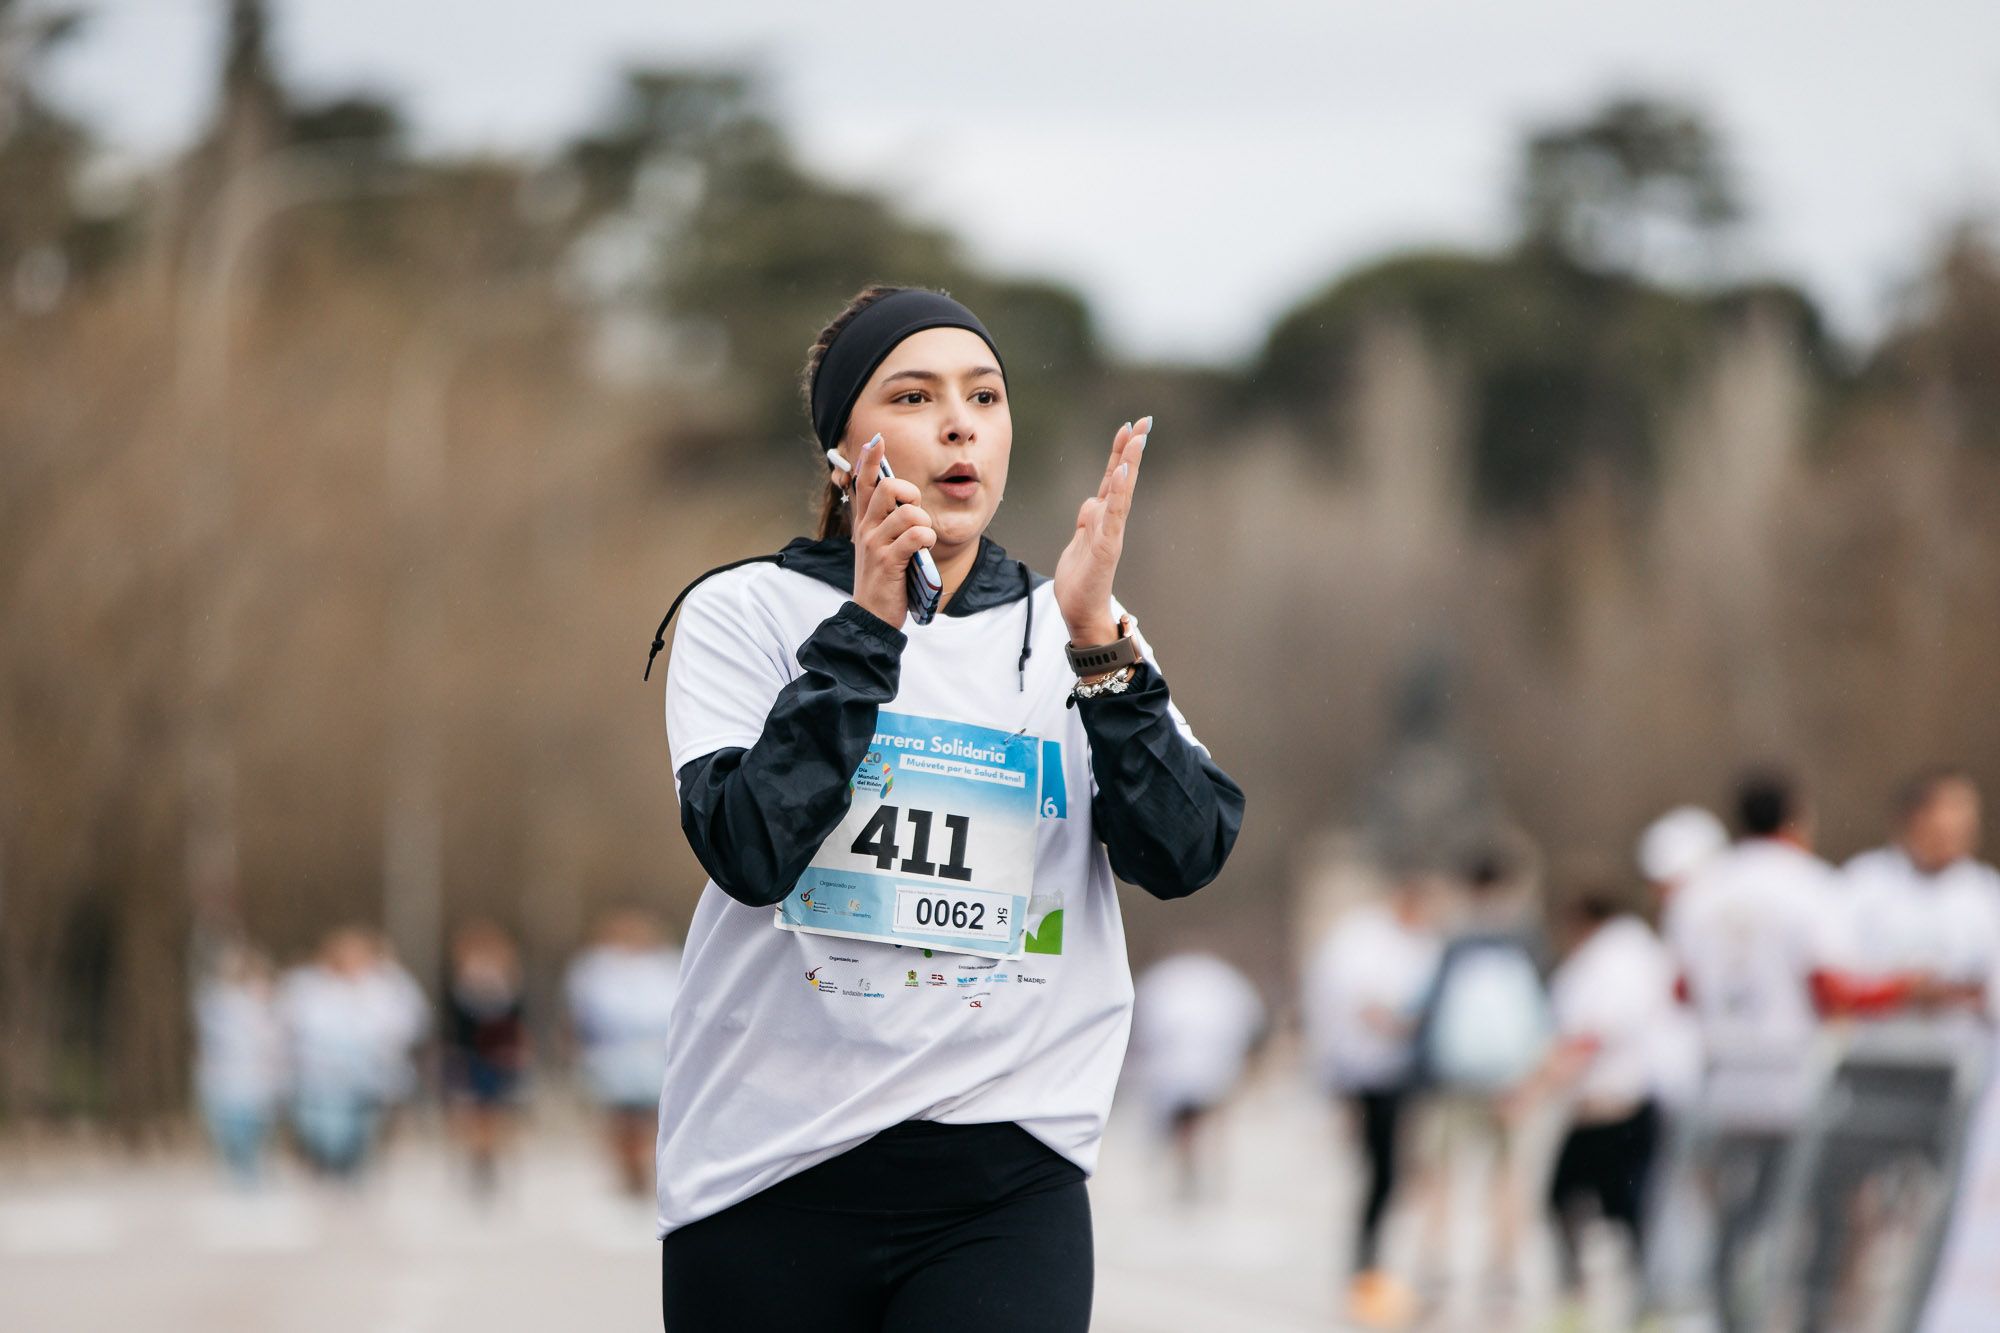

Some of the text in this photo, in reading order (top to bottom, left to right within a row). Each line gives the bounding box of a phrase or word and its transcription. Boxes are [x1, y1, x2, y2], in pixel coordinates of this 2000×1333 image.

[930, 735, 1006, 764] Solidaria
[906, 757, 946, 771] Muévete
[947, 765, 963, 774] por
[974, 768, 998, 779] Salud
[999, 772, 1022, 783] Renal
[1040, 797, 1058, 818] 6
[851, 805, 972, 881] 411
[819, 880, 847, 889] Organizado
[916, 897, 985, 930] 0062
[997, 907, 1008, 925] 5K
[969, 1000, 982, 1008] CSL
